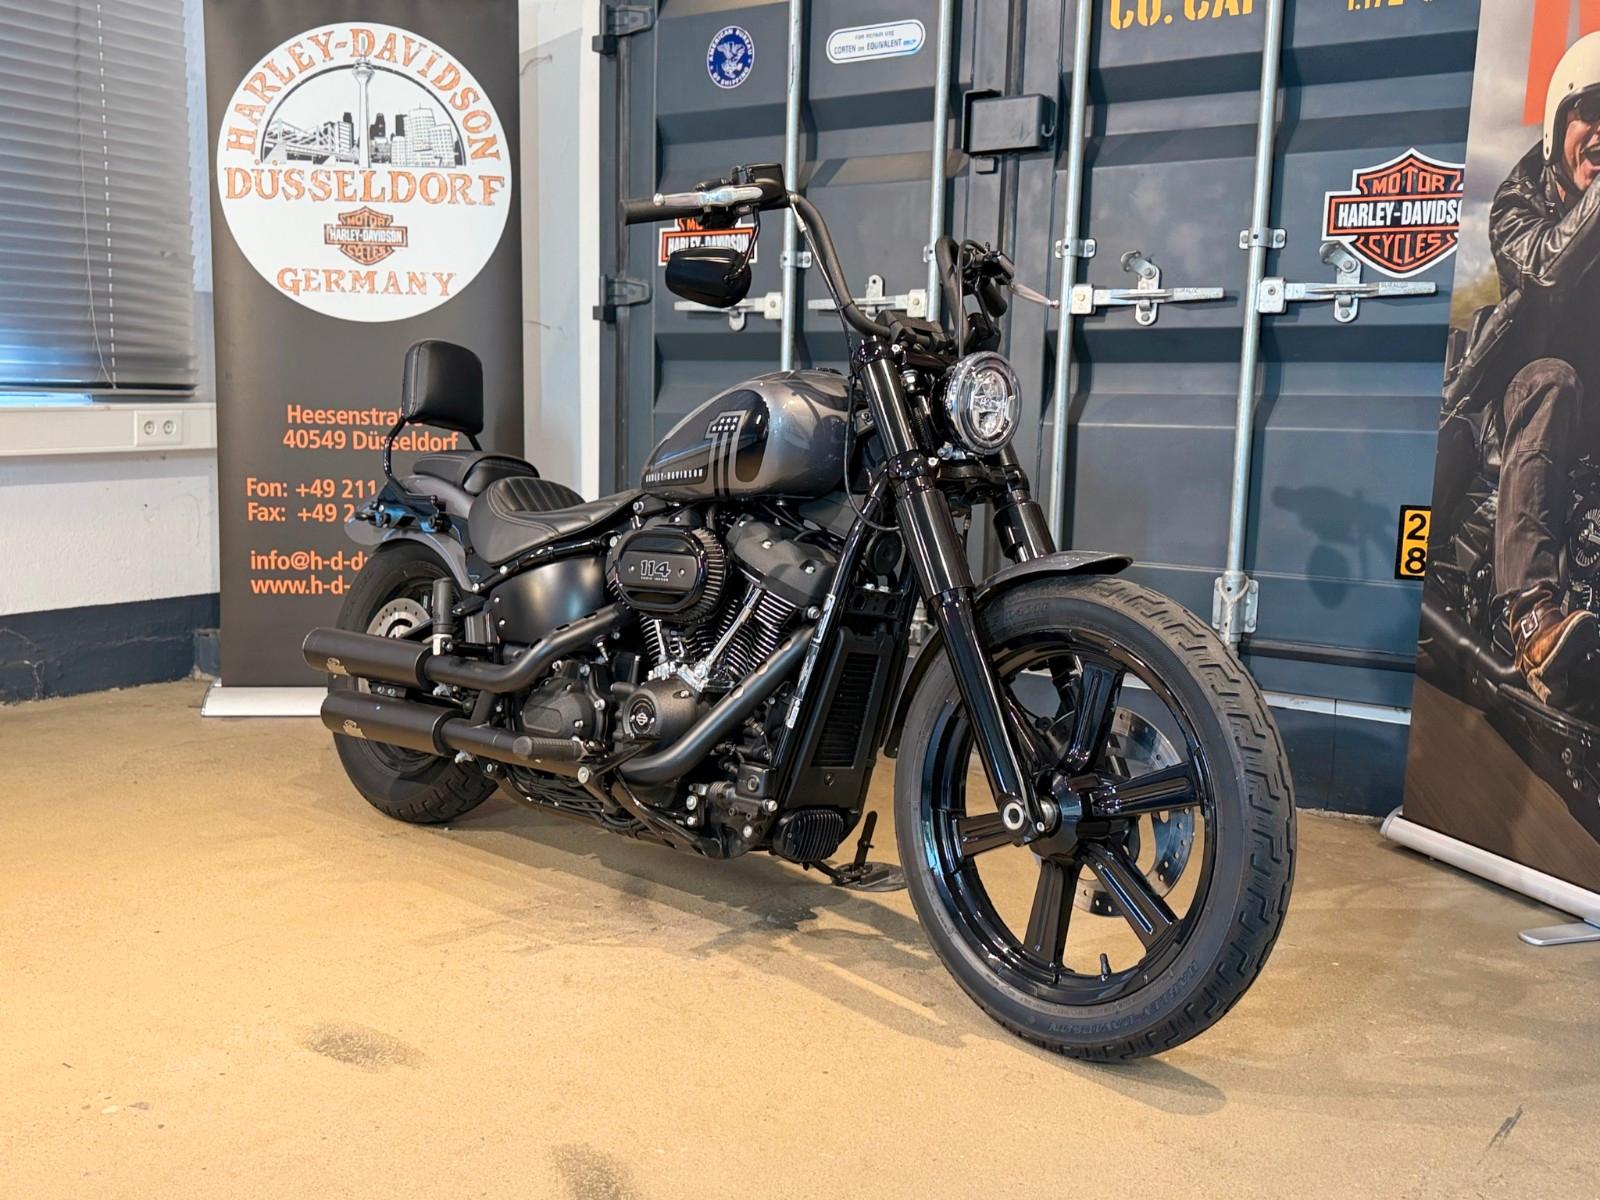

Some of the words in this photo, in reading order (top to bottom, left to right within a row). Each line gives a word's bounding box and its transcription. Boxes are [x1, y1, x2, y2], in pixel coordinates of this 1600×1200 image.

[834, 44, 856, 55] CORTEN
[866, 38, 902, 51] EQUIVALENT
[226, 28, 501, 162] HARLEY-DAVIDSON
[224, 158, 505, 206] DÜSSELDORF
[1372, 165, 1445, 195] MOTOR
[329, 227, 402, 243] HARLEY-DAVIDSON
[1368, 233, 1442, 264] CYCLES
[276, 267, 456, 297] GERMANY
[287, 404, 423, 426] Heesenstra
[283, 430, 346, 450] 40549
[352, 431, 459, 451] Düsseldorf
[246, 477, 288, 498] Fon:
[296, 479, 336, 498] +49
[341, 479, 377, 499] 211
[248, 502, 286, 522] Fax:
[297, 503, 338, 522] +49
[250, 550, 369, 571] info@h-d-d
[640, 559, 672, 578] 114
